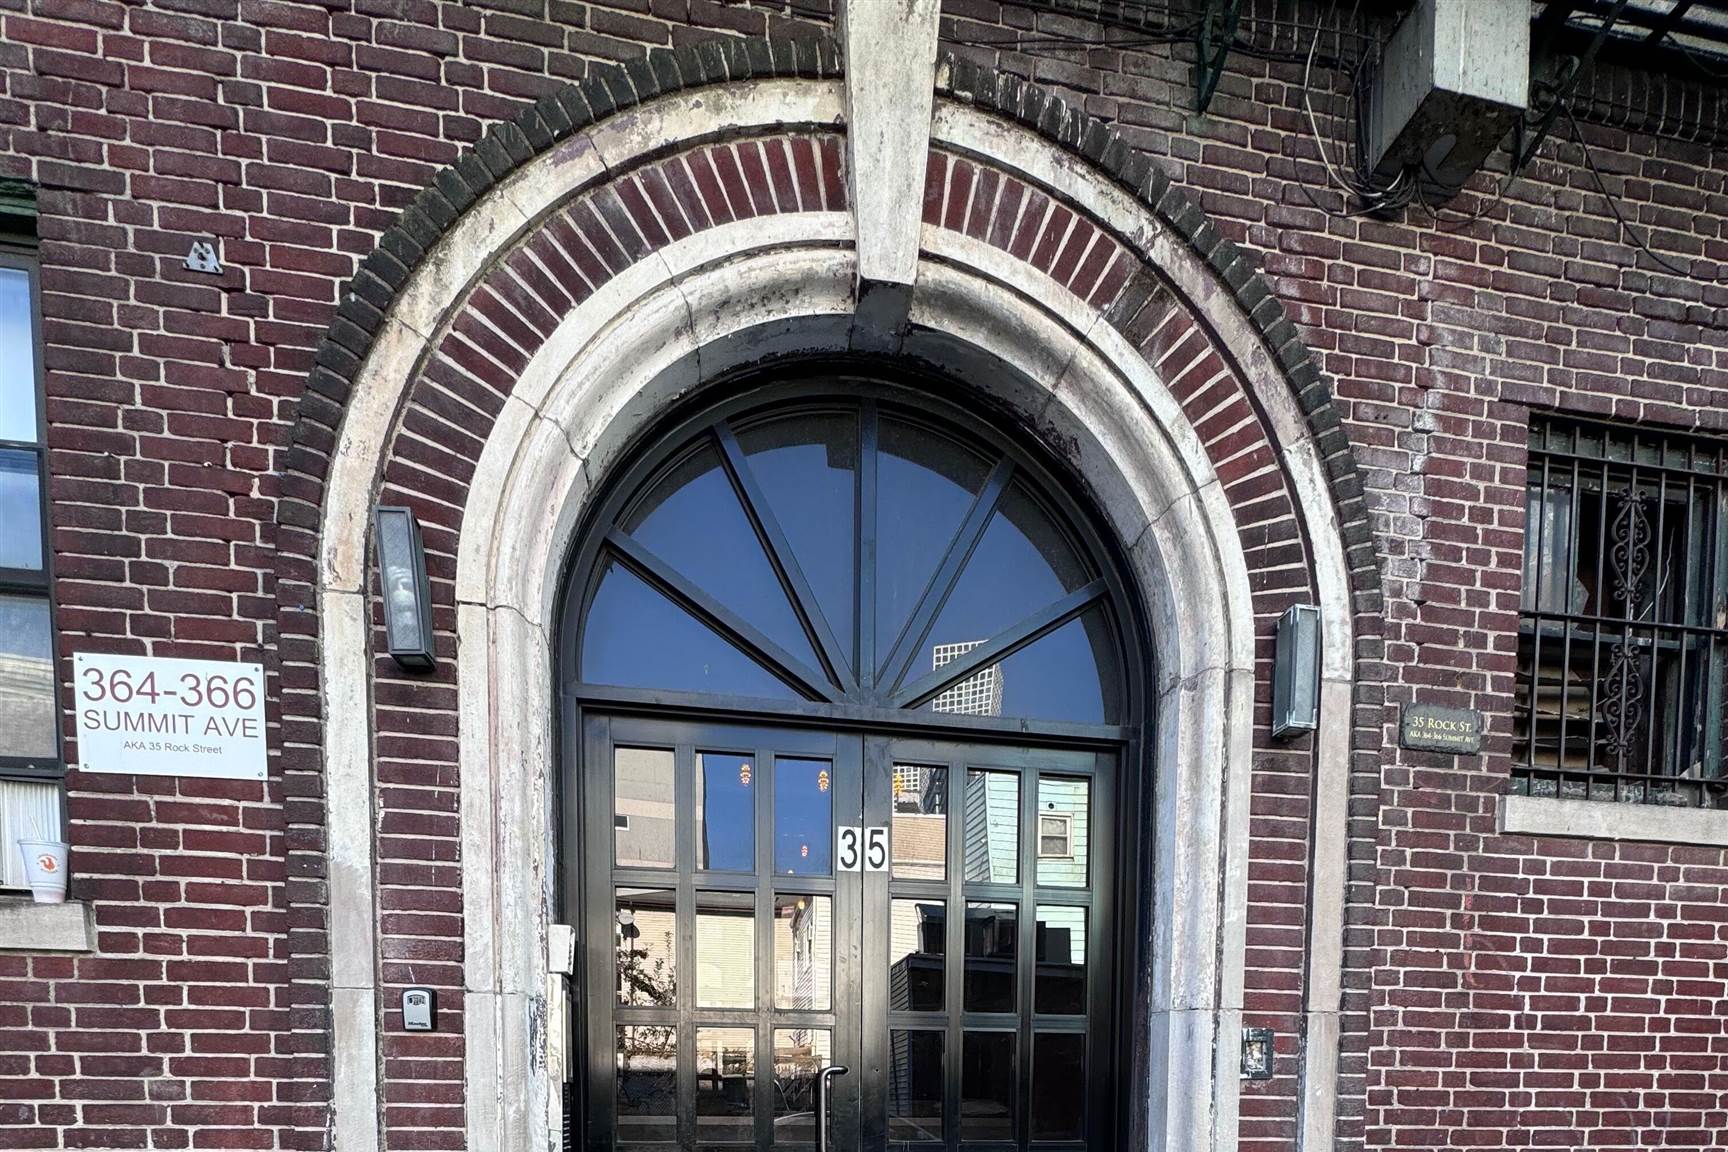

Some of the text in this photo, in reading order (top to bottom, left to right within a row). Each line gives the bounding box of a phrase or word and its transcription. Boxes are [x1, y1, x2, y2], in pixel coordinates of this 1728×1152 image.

[82, 667, 257, 710] 364-366
[83, 709, 259, 738] SUMMIT AVE
[1412, 716, 1425, 728] 35
[1428, 718, 1456, 731] ROCK
[123, 740, 223, 755] AKA 35 Rock Street
[840, 829, 886, 869] 35
